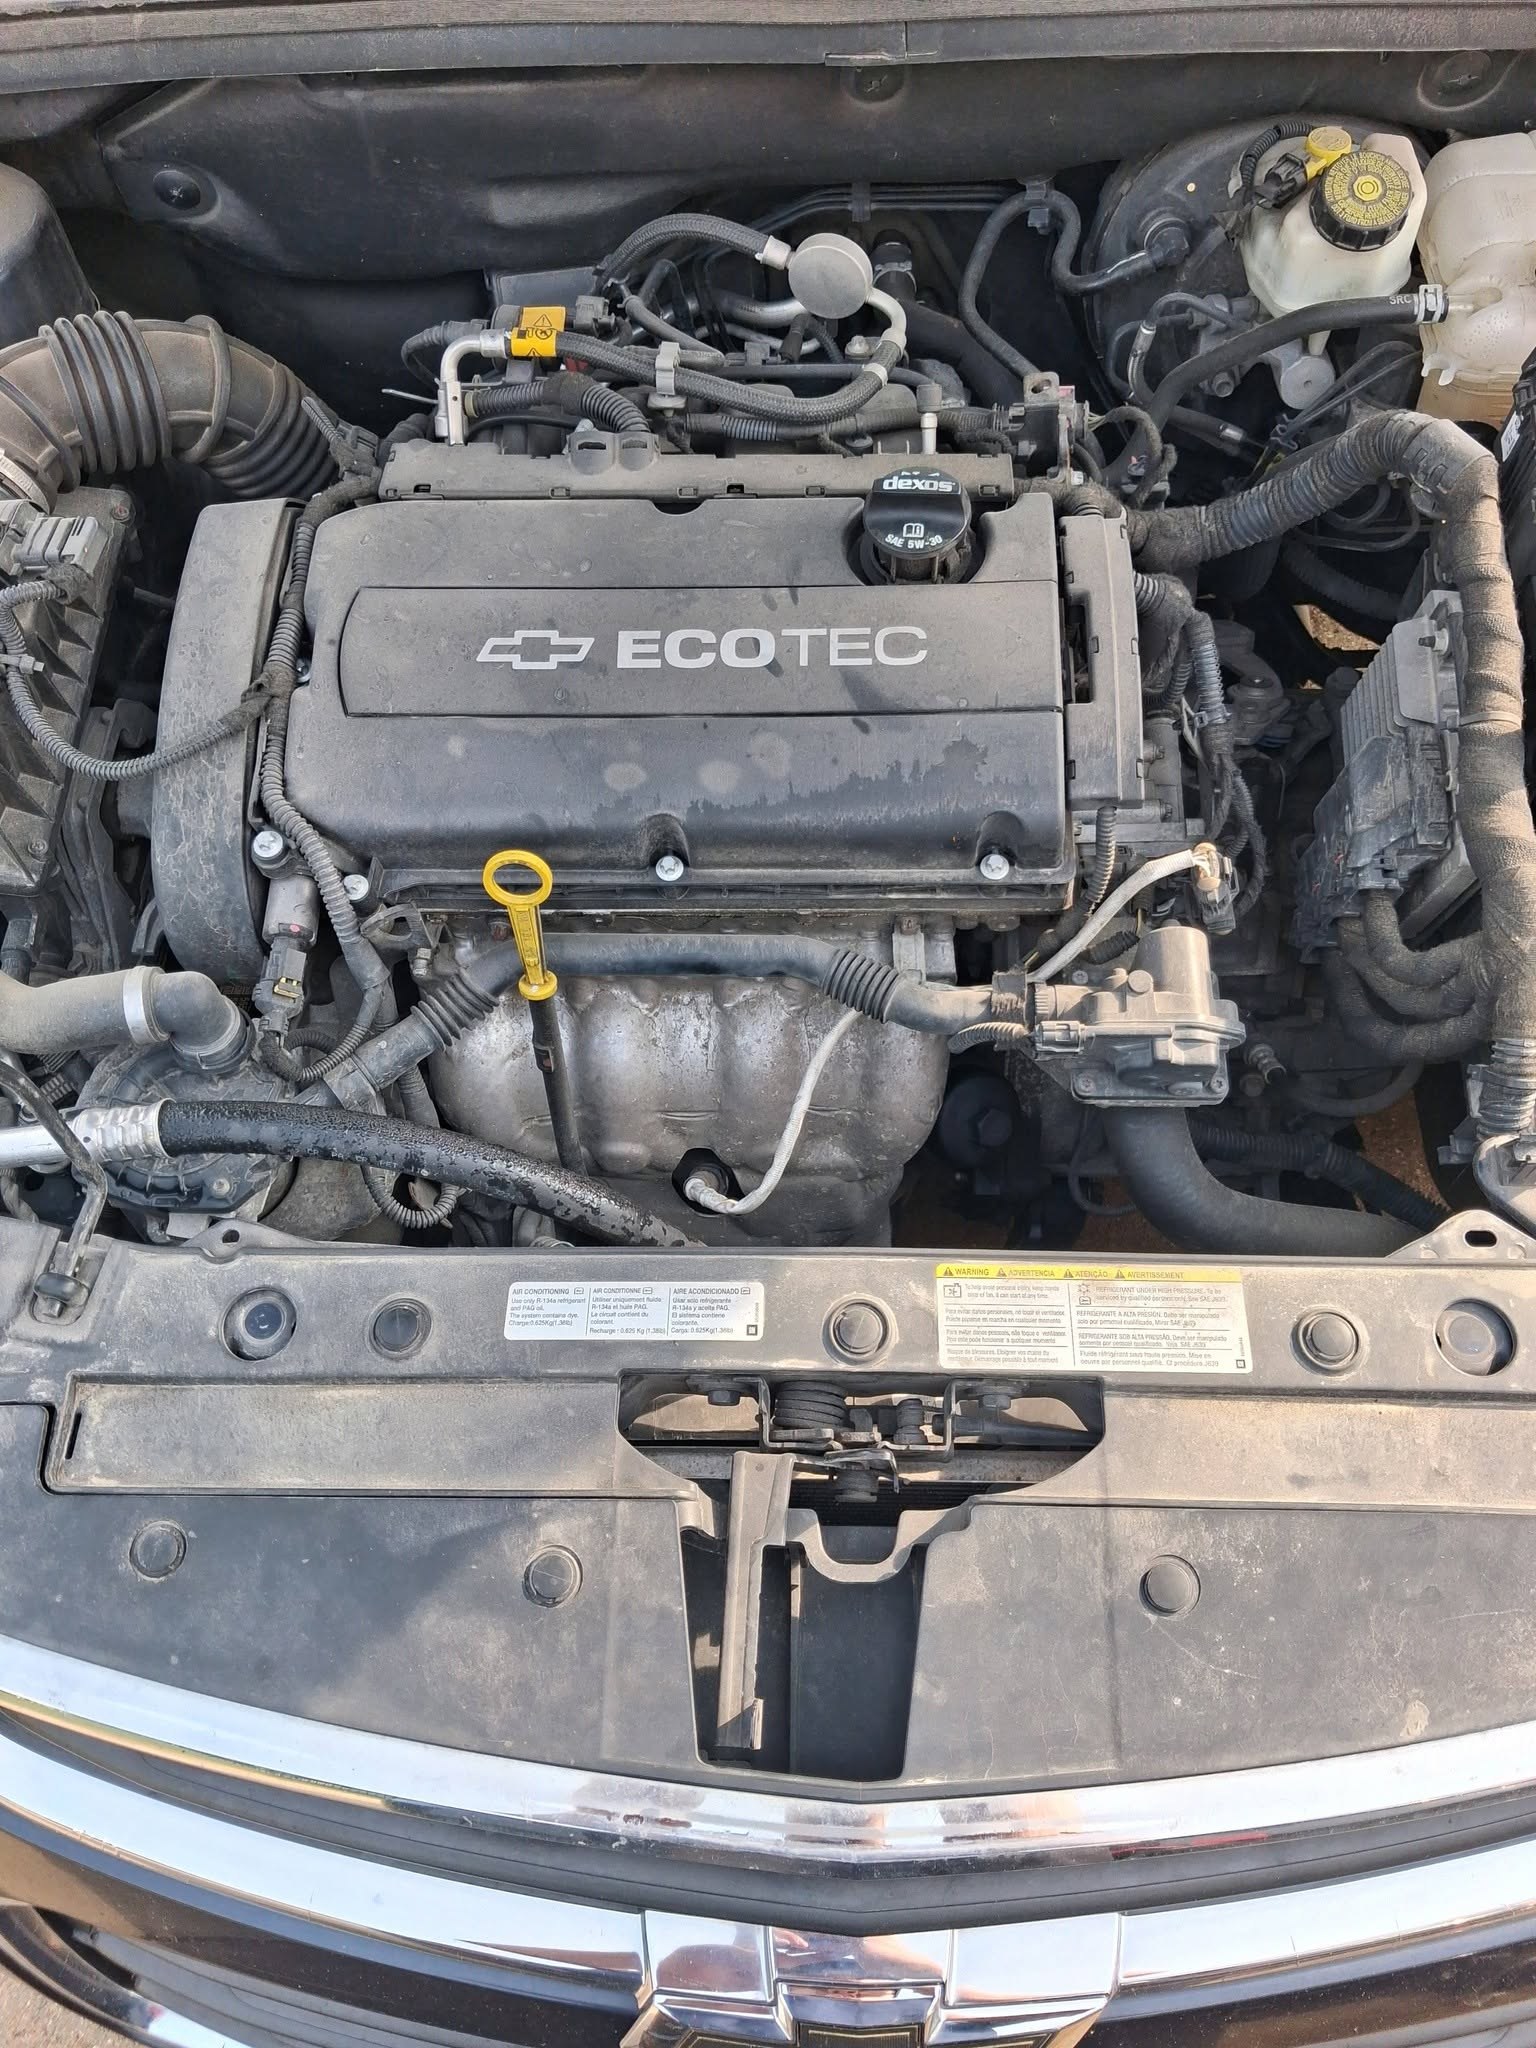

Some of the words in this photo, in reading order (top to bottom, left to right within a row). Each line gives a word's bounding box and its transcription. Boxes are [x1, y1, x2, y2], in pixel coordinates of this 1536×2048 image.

[1389, 295, 1412, 305] SRC
[882, 476, 953, 492] dexos
[885, 534, 905, 547] SAE
[908, 534, 943, 549] 5W-30
[616, 626, 928, 669] ECOTEC
